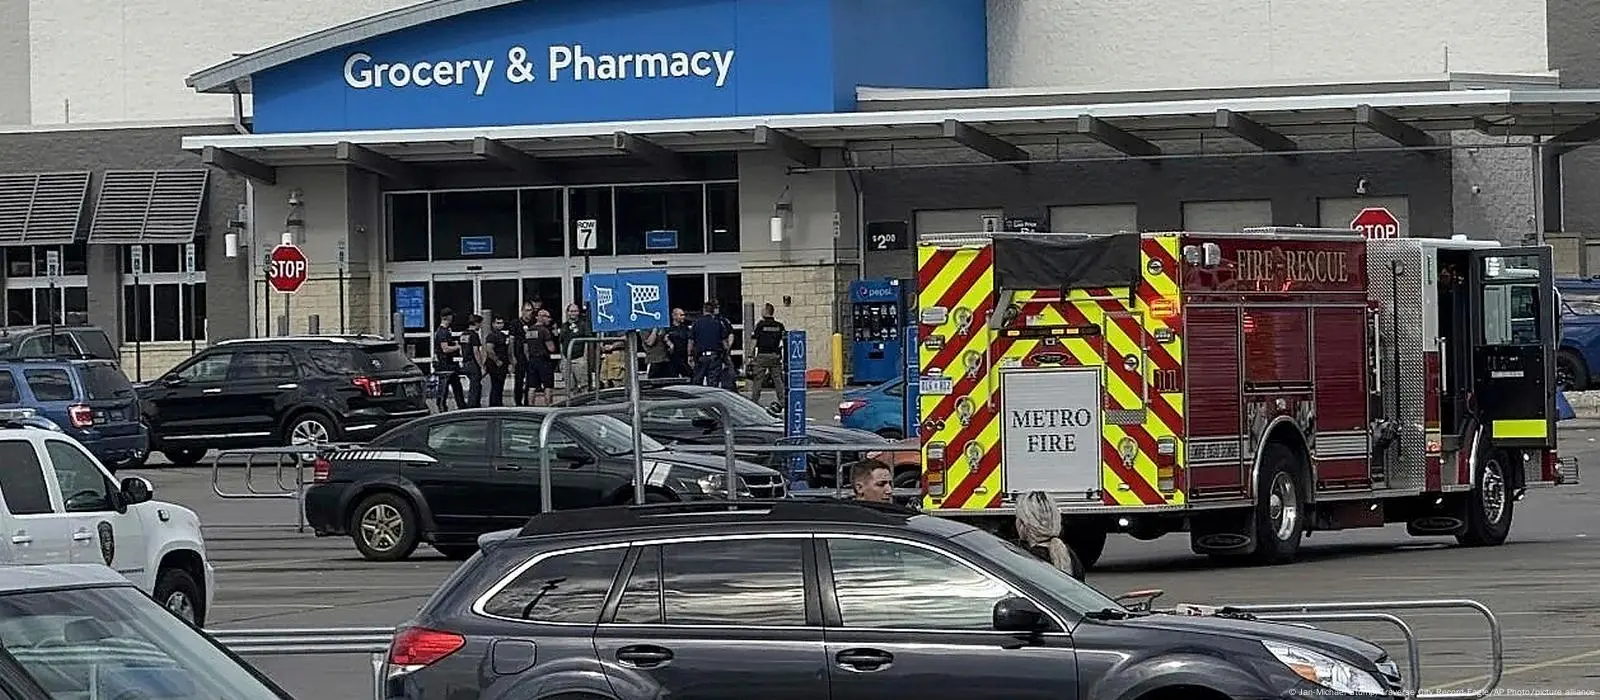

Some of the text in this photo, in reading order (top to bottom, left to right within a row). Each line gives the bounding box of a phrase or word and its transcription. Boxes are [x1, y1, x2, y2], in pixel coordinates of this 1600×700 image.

[344, 45, 734, 95] Grocery & Pharmacy
[581, 229, 592, 248] 7
[269, 260, 304, 278] STOP
[869, 288, 892, 297] pepsi
[792, 340, 804, 359] 20
[1156, 370, 1178, 391] 11
[1012, 409, 1091, 427] METRO
[1028, 434, 1076, 452] FIRE
